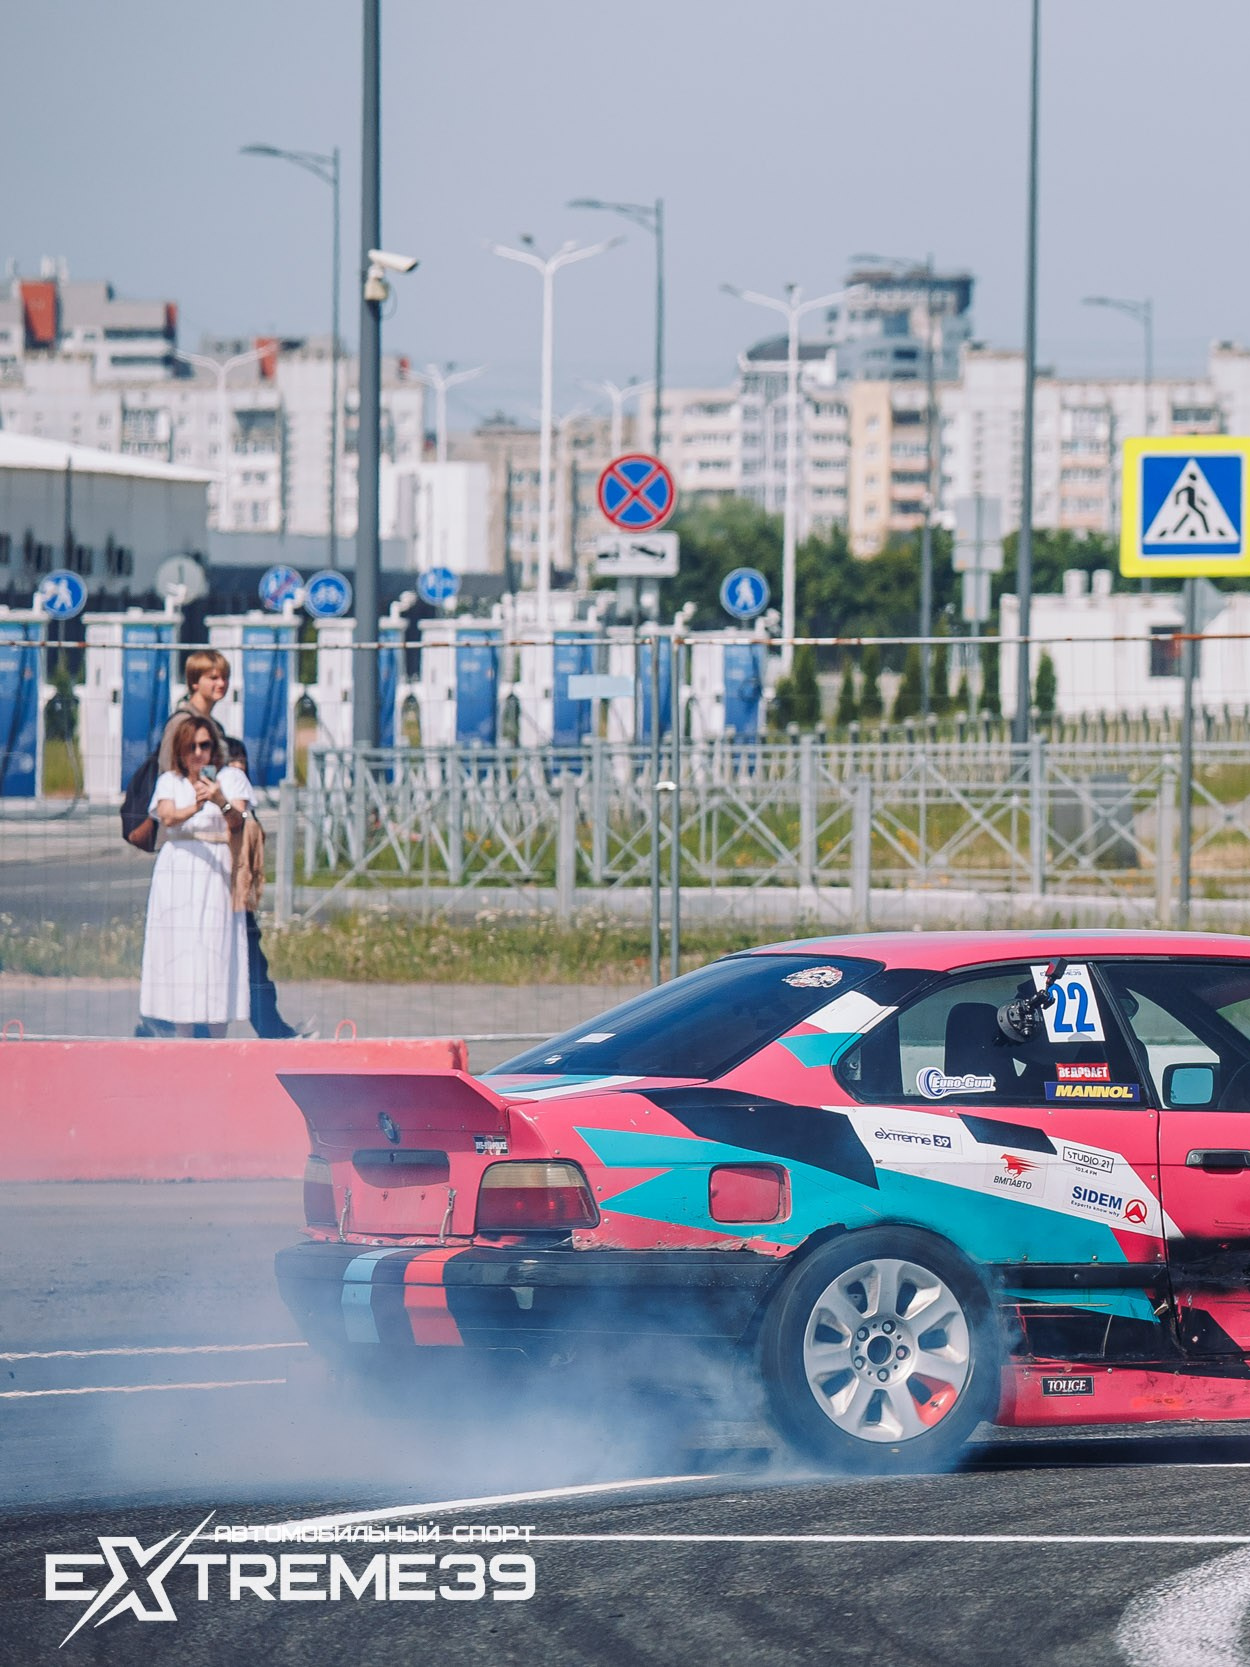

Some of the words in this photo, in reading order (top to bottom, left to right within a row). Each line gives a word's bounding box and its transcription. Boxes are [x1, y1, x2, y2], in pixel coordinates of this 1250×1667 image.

[1048, 982, 1096, 1033] 22
[1055, 1084, 1134, 1099] MANNOL
[935, 1136, 950, 1148] 39
[1067, 1151, 1099, 1166] STUDIO
[1100, 1159, 1110, 1169] 21
[1089, 1169, 1098, 1177] FM
[993, 1175, 1033, 1190] ВМПАВТО
[1072, 1185, 1123, 1211] SIDEM
[1071, 1200, 1092, 1210] Experts
[1093, 1204, 1108, 1213] know
[1109, 1210, 1120, 1218] why
[1047, 1380, 1087, 1393] TOUGE
